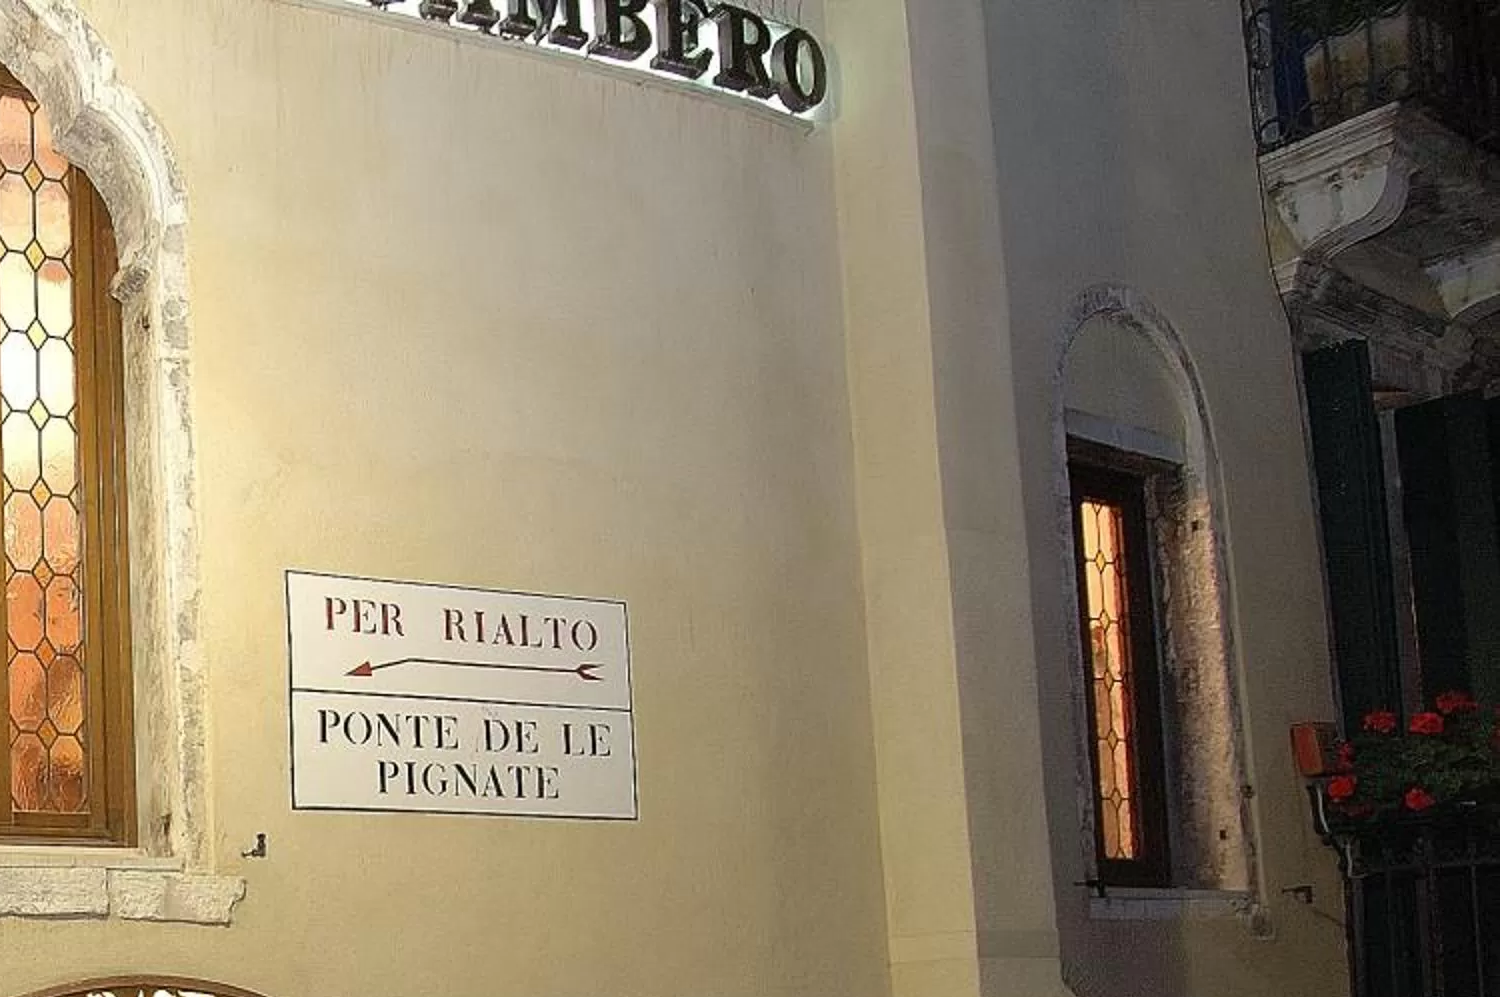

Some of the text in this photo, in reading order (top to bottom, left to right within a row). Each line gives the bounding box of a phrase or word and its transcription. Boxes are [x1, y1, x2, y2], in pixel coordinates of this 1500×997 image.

[368, 0, 827, 112] MBERO
[325, 597, 598, 651] PER RIALTO
[317, 709, 611, 757] PONTE DE LE
[376, 760, 560, 799] PIGNATE
